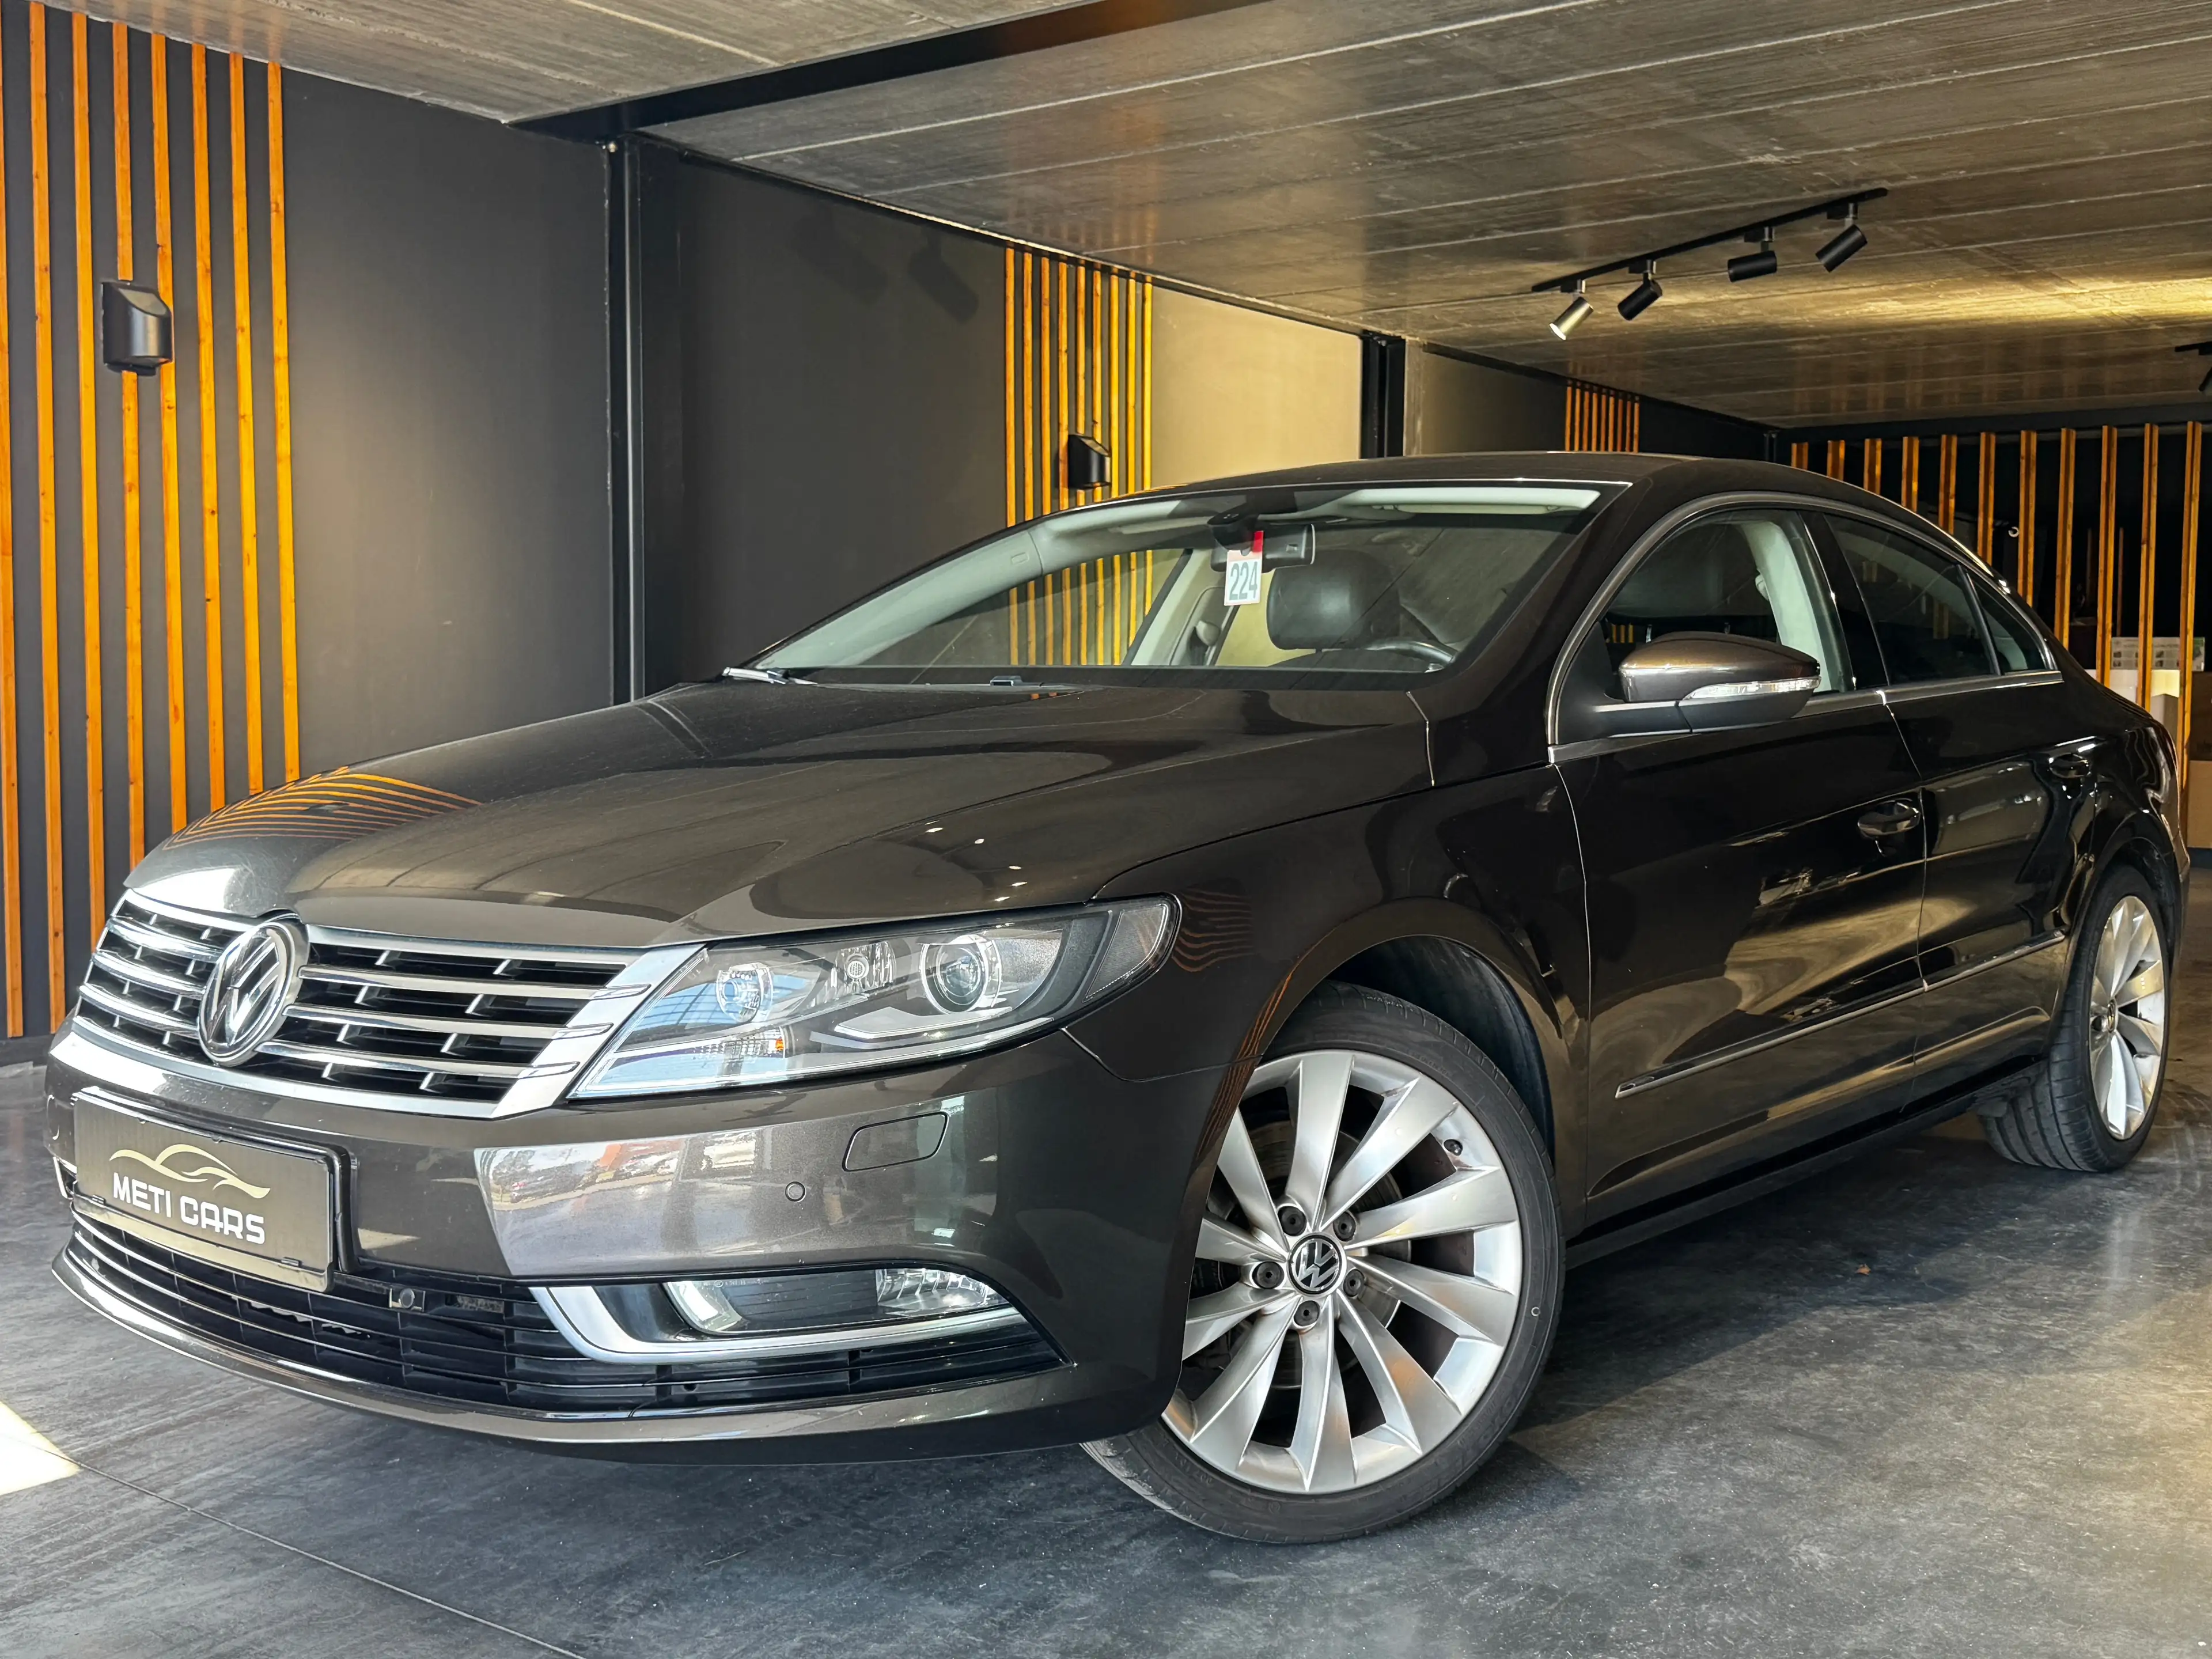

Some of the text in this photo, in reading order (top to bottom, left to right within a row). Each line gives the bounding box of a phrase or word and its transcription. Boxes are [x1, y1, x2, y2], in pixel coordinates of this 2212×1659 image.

[1229, 561, 1258, 601] 224
[113, 1172, 266, 1245] METI CARS
[1296, 1239, 1339, 1289] VW
